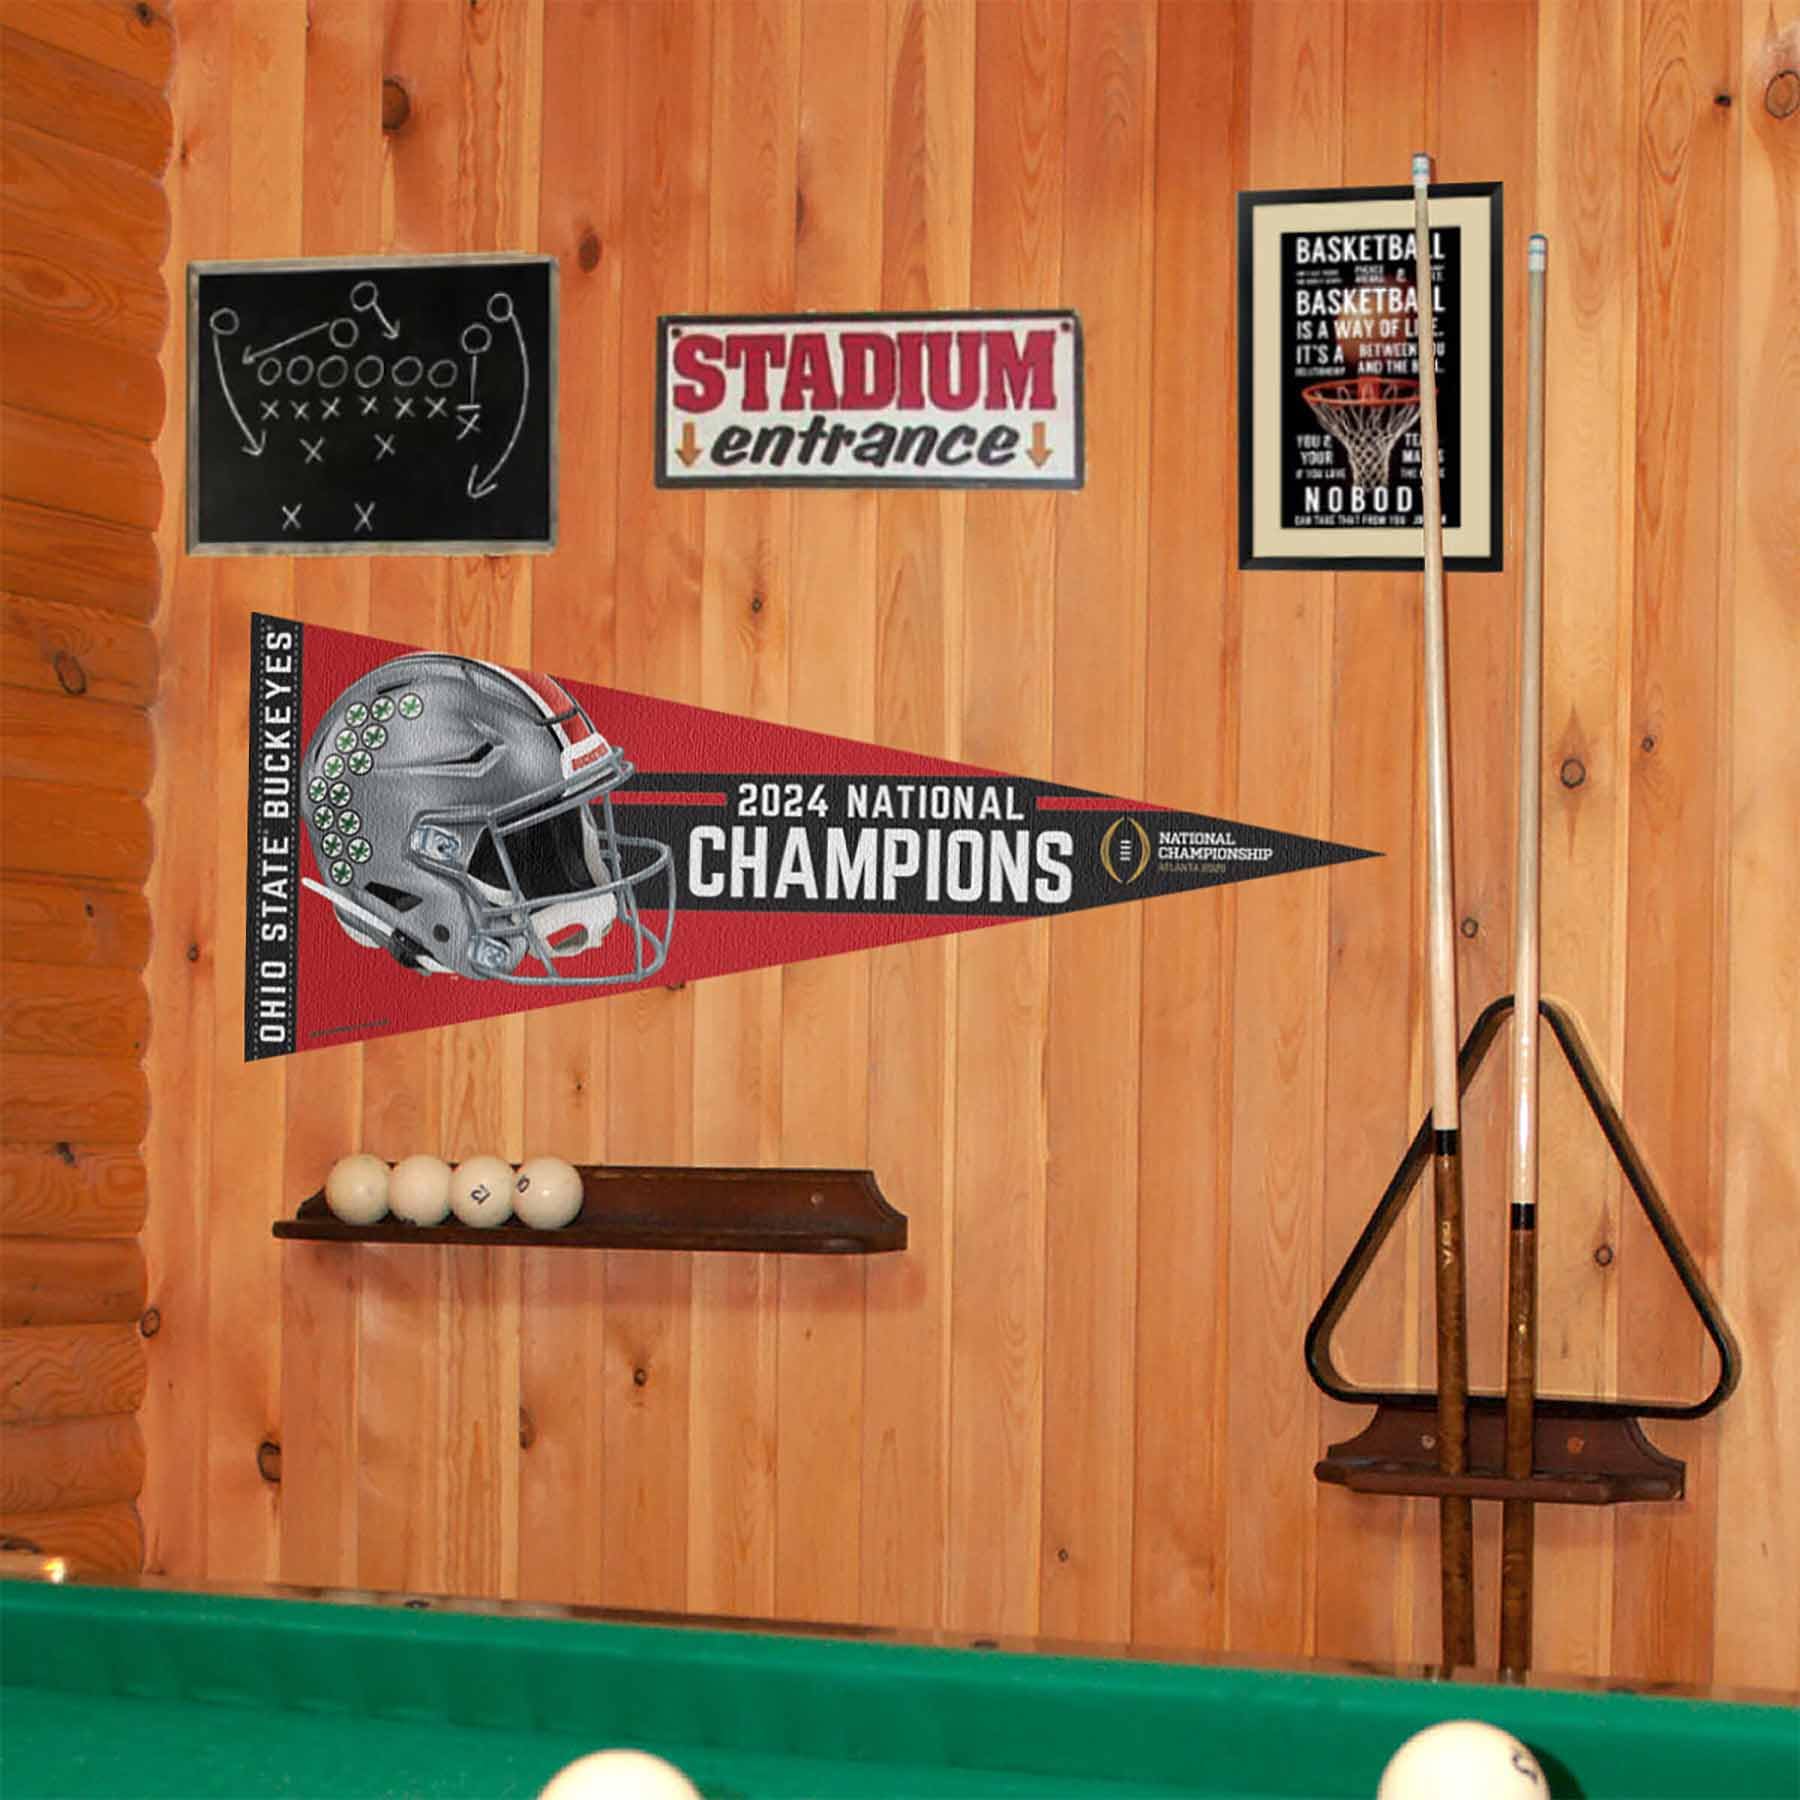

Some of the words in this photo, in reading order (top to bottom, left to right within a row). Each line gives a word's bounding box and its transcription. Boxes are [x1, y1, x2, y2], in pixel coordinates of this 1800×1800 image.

[1296, 233, 1446, 264] BASKETBAL
[1296, 286, 1446, 316] BASKETBAL
[1297, 320, 1313, 340] IS
[1317, 320, 1329, 339] A
[1334, 318, 1375, 340] WAY
[1380, 318, 1400, 338] OF
[672, 330, 1057, 413] STADIUM
[1296, 344, 1329, 365] IT'S
[1333, 344, 1345, 365] A
[710, 415, 1020, 468] entrance
[1305, 486, 1415, 513] NOBOD
[263, 631, 292, 819] BUCKEYES
[738, 783, 829, 818] 2024
[847, 784, 1025, 821] NATIONAL
[1157, 846, 1273, 861] CHAMPIONSHIP
[1158, 831, 1236, 846] NATIONAL
[688, 825, 1074, 904] CHAMPIONS
[262, 836, 289, 942] STATE
[259, 960, 287, 1043] OHIO
